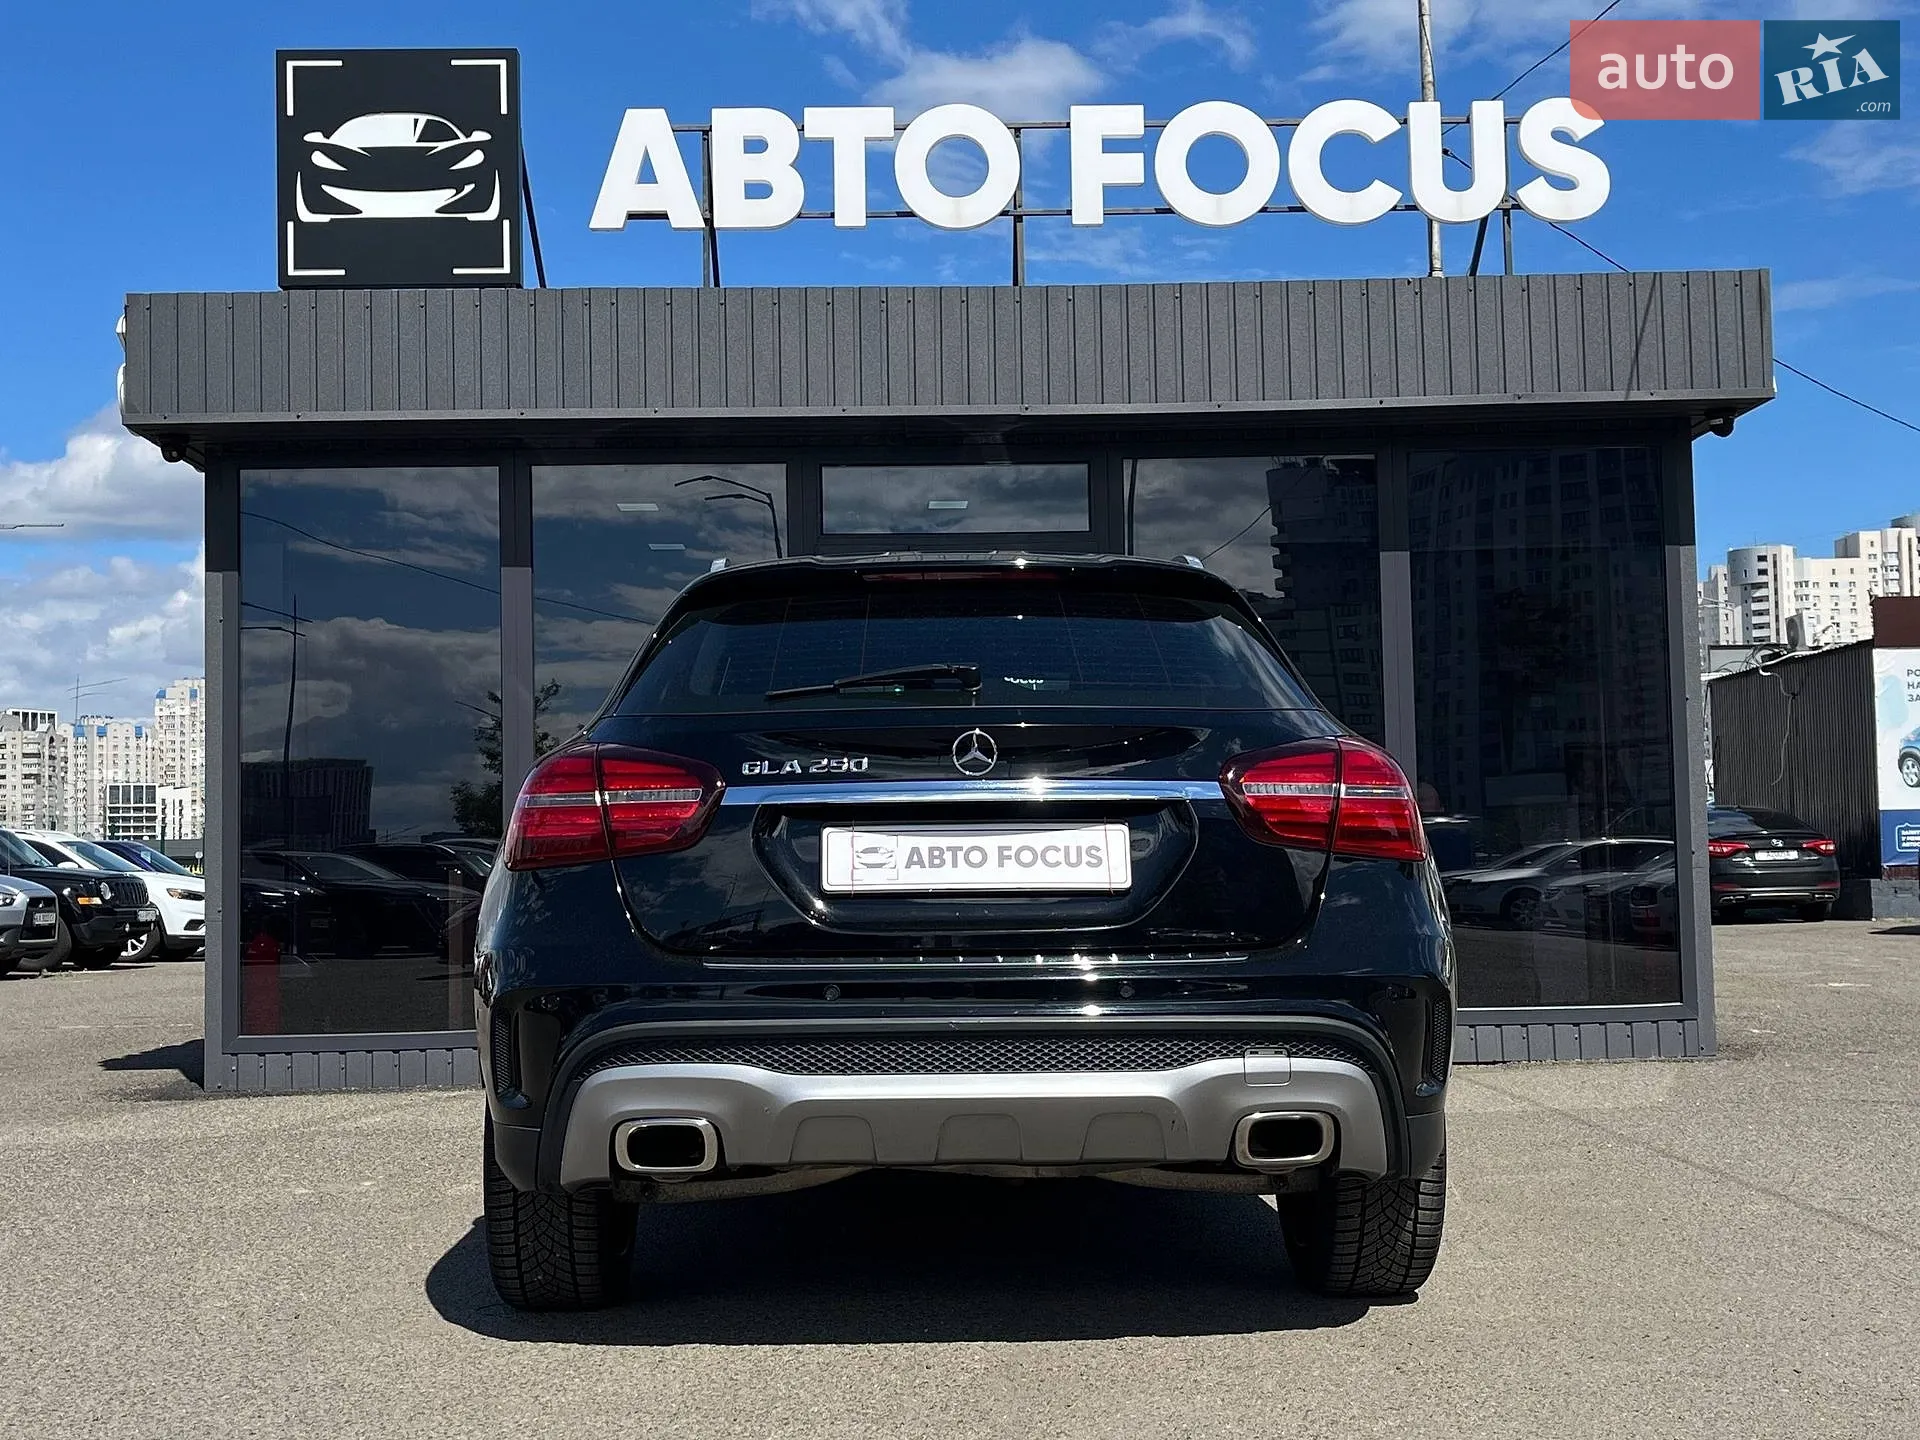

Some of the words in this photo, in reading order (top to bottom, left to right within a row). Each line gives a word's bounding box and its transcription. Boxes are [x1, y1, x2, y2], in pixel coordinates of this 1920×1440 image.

[588, 104, 1021, 231] АВТО
[1069, 97, 1611, 228] FOCUS
[741, 759, 802, 776] GLA
[808, 756, 869, 774] 250
[904, 845, 988, 869] АВТО
[997, 845, 1103, 869] FOCUS
